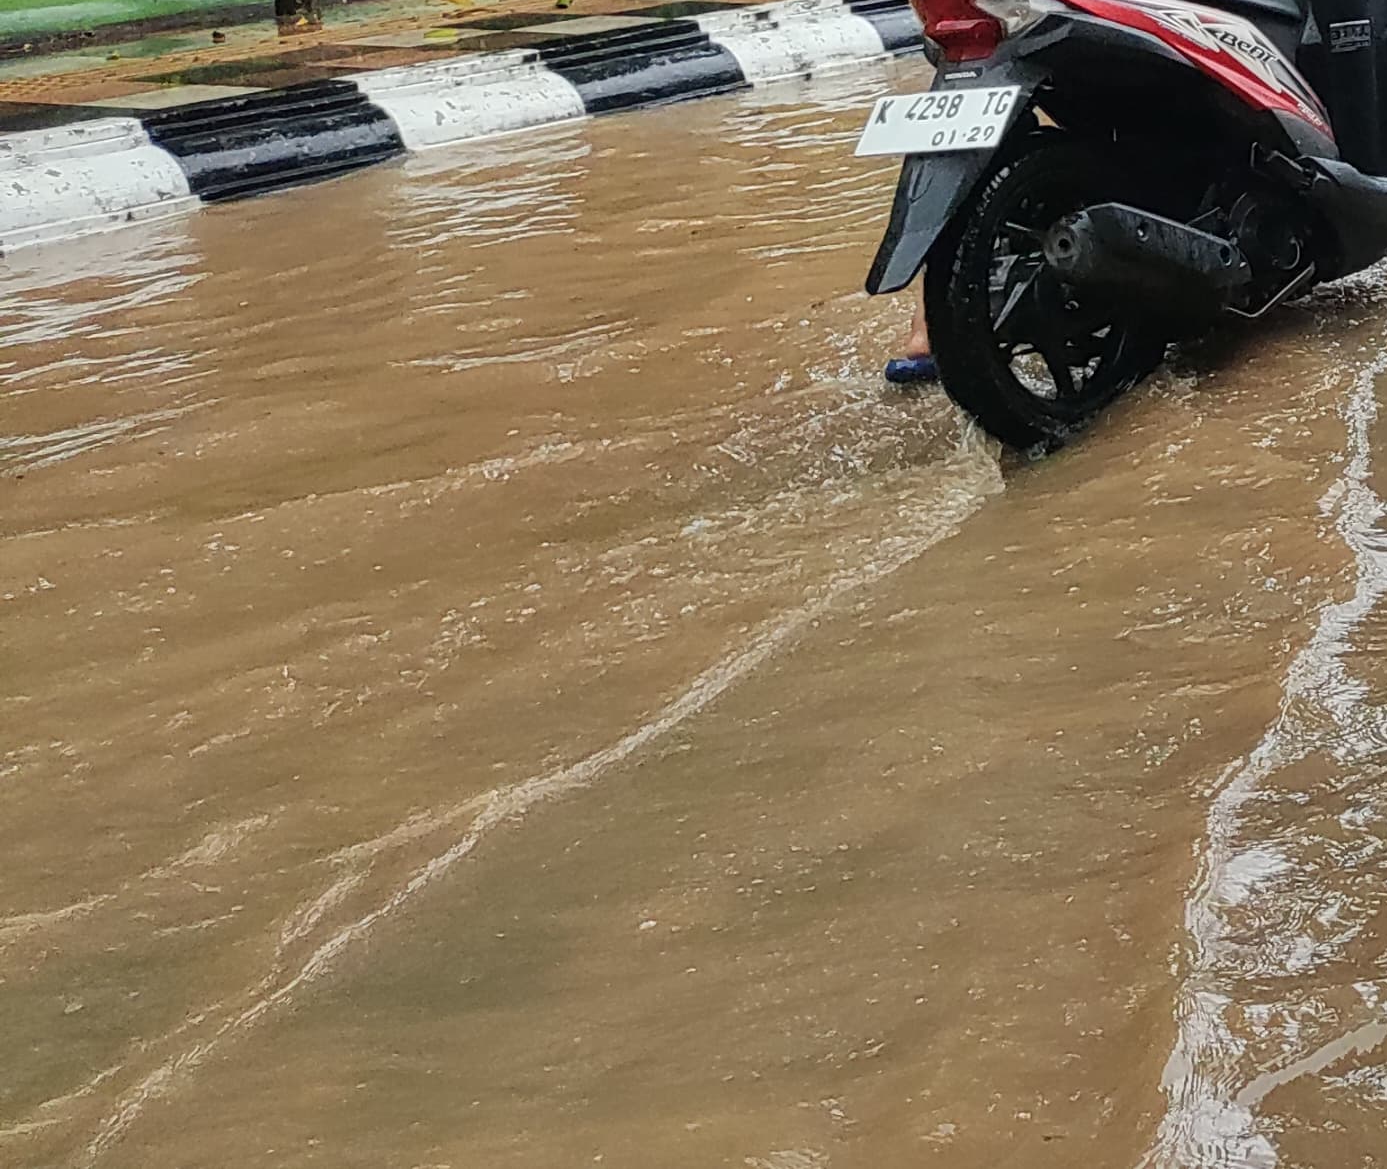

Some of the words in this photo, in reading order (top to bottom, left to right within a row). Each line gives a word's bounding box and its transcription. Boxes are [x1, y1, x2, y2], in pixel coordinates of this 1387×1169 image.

[874, 100, 895, 125] K
[904, 93, 964, 122] 4298
[981, 90, 1013, 116] TG
